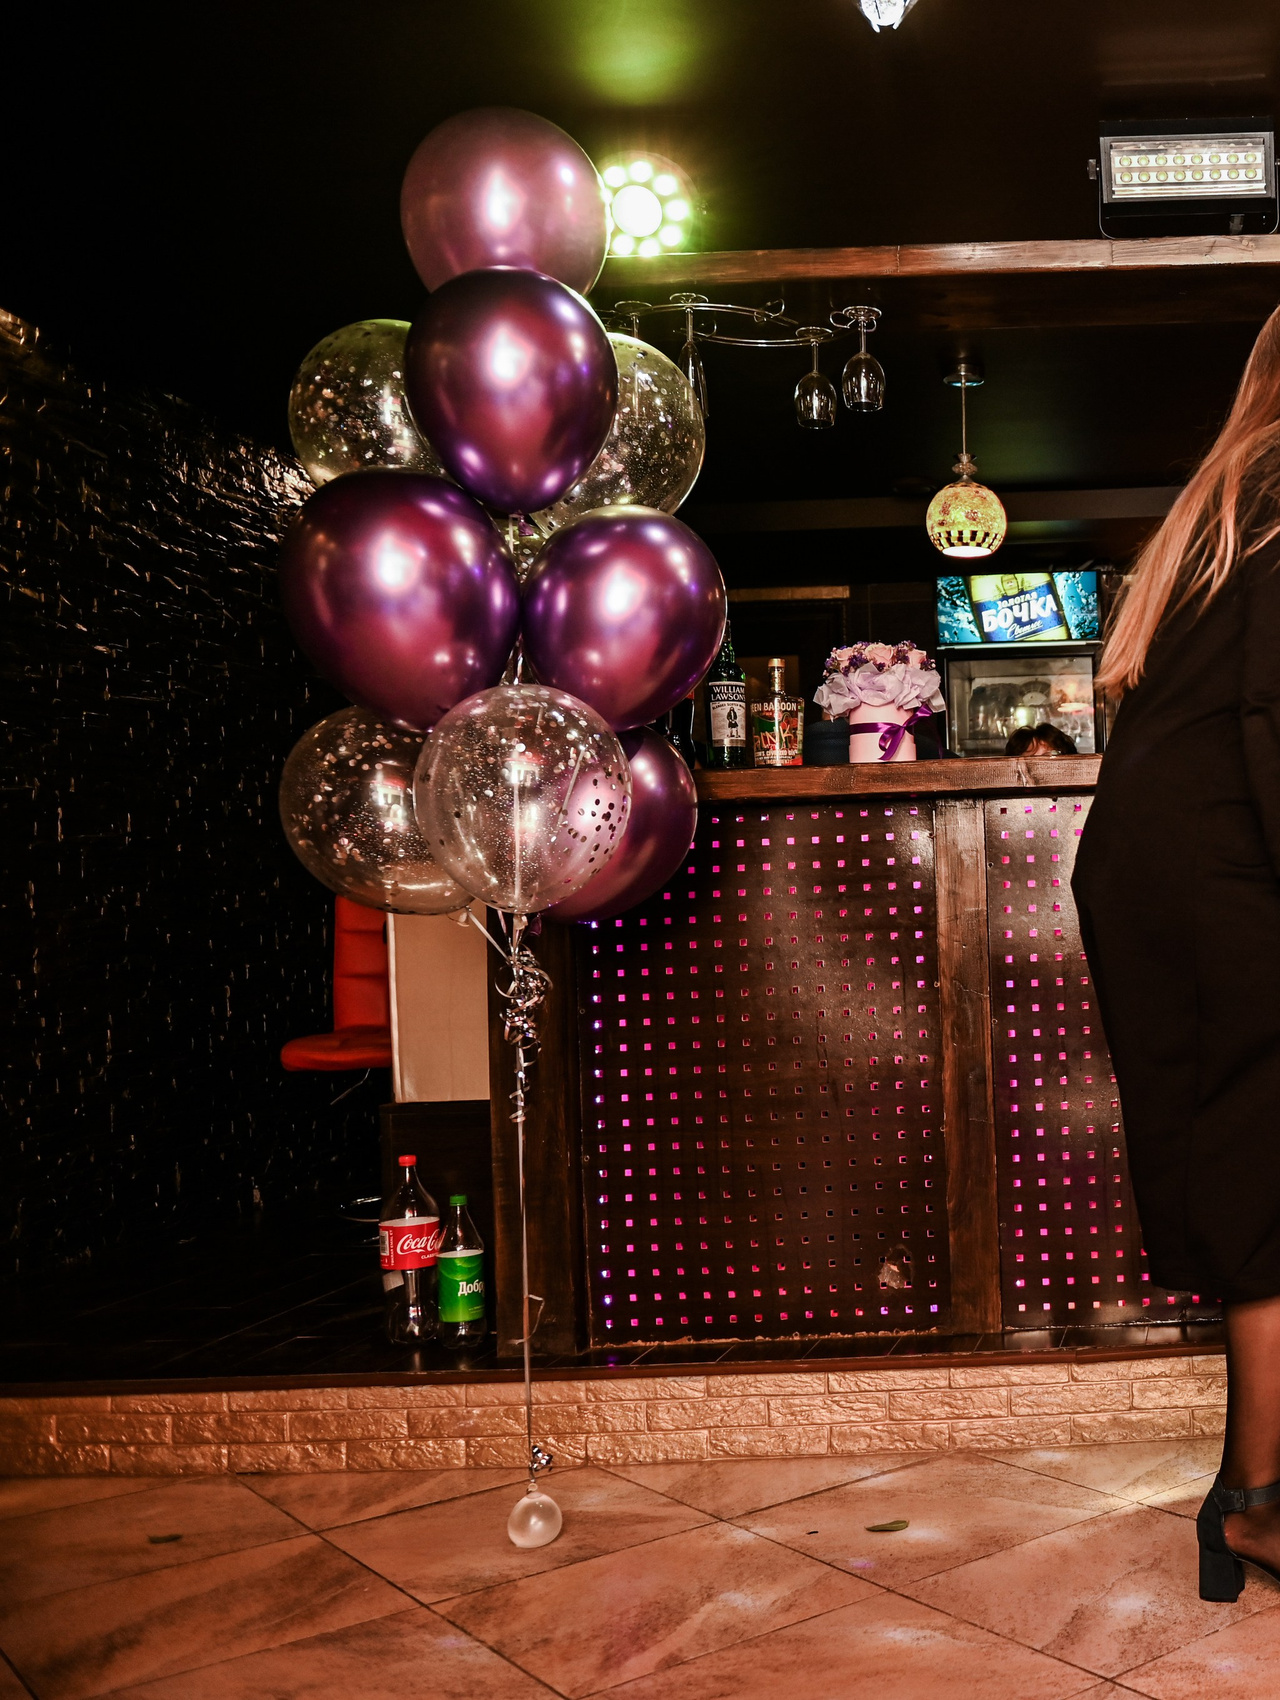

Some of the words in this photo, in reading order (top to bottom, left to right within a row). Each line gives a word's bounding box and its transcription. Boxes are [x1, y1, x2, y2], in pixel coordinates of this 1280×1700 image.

[998, 591, 1038, 608] ЗОЛОТАЯ
[981, 594, 1058, 633] БОЧКА
[763, 702, 797, 712] BABOON
[457, 1279, 484, 1297] Добр
